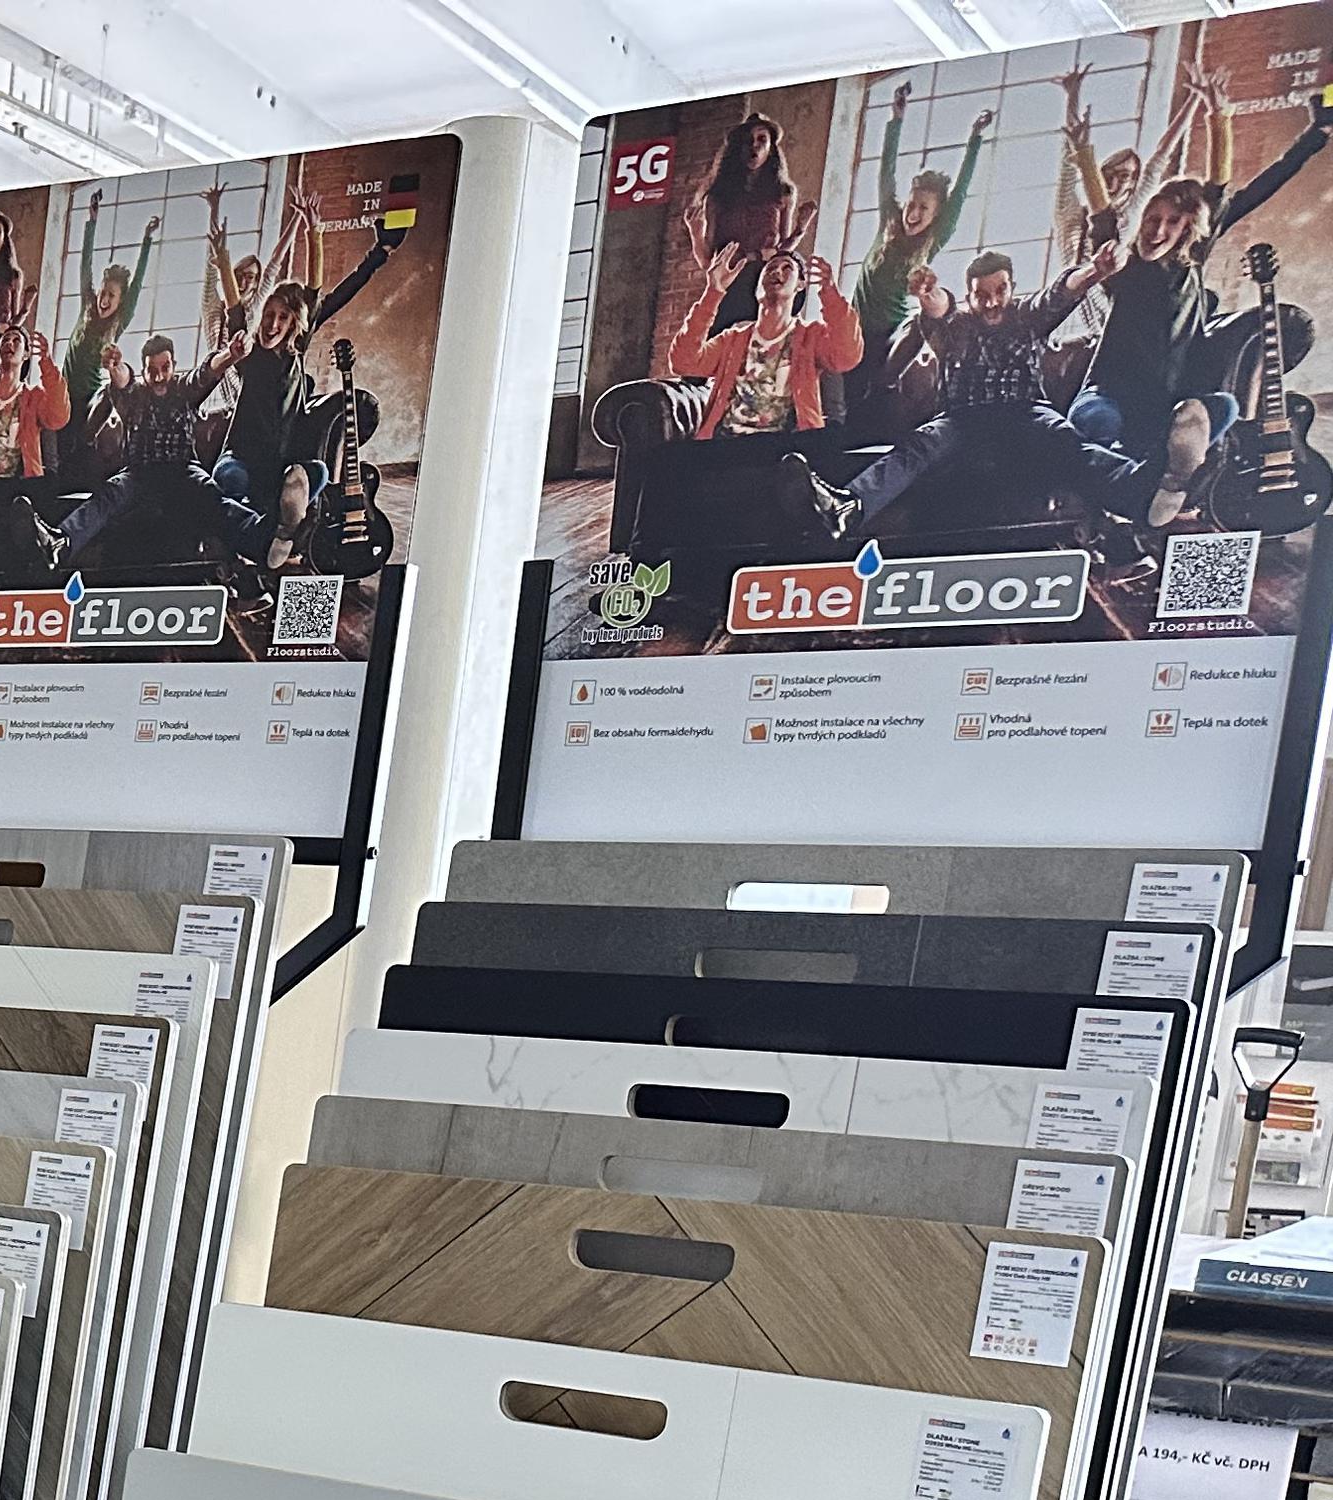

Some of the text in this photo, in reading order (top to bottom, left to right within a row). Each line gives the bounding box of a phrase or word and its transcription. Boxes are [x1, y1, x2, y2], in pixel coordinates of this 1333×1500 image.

[613, 145, 671, 195] 5G
[345, 180, 383, 196] MADE
[362, 198, 381, 212] IN
[589, 562, 632, 586] save
[743, 570, 1073, 621] the floor
[77, 598, 216, 636] floor
[1147, 619, 1255, 633] Floorstudio
[266, 646, 341, 657] Floorstudio
[781, 673, 881, 687] Instalace plovoucím
[995, 673, 1051, 687] Bezprašné
[1190, 668, 1277, 681] Redukce hluku
[599, 687, 616, 697] 100
[617, 686, 627, 697] %
[779, 687, 832, 699] způsobem
[775, 716, 925, 729] Možnost instalace na všechny
[989, 712, 1031, 724] Vhodná
[1182, 715, 1269, 730] Teplá na dotek
[593, 727, 610, 738] Bez
[612, 726, 646, 738] obsahu
[774, 731, 796, 742] typy
[798, 729, 835, 743] tvrdých
[987, 728, 1006, 739] pro
[1008, 725, 1068, 739] podlahové
[1226, 1269, 1309, 1289] CLASSEN
[1153, 1447, 1188, 1464] 194,-
[1191, 1449, 1212, 1465] KČ
[1214, 1455, 1234, 1468] vč.
[1238, 1458, 1270, 1472] DPH
